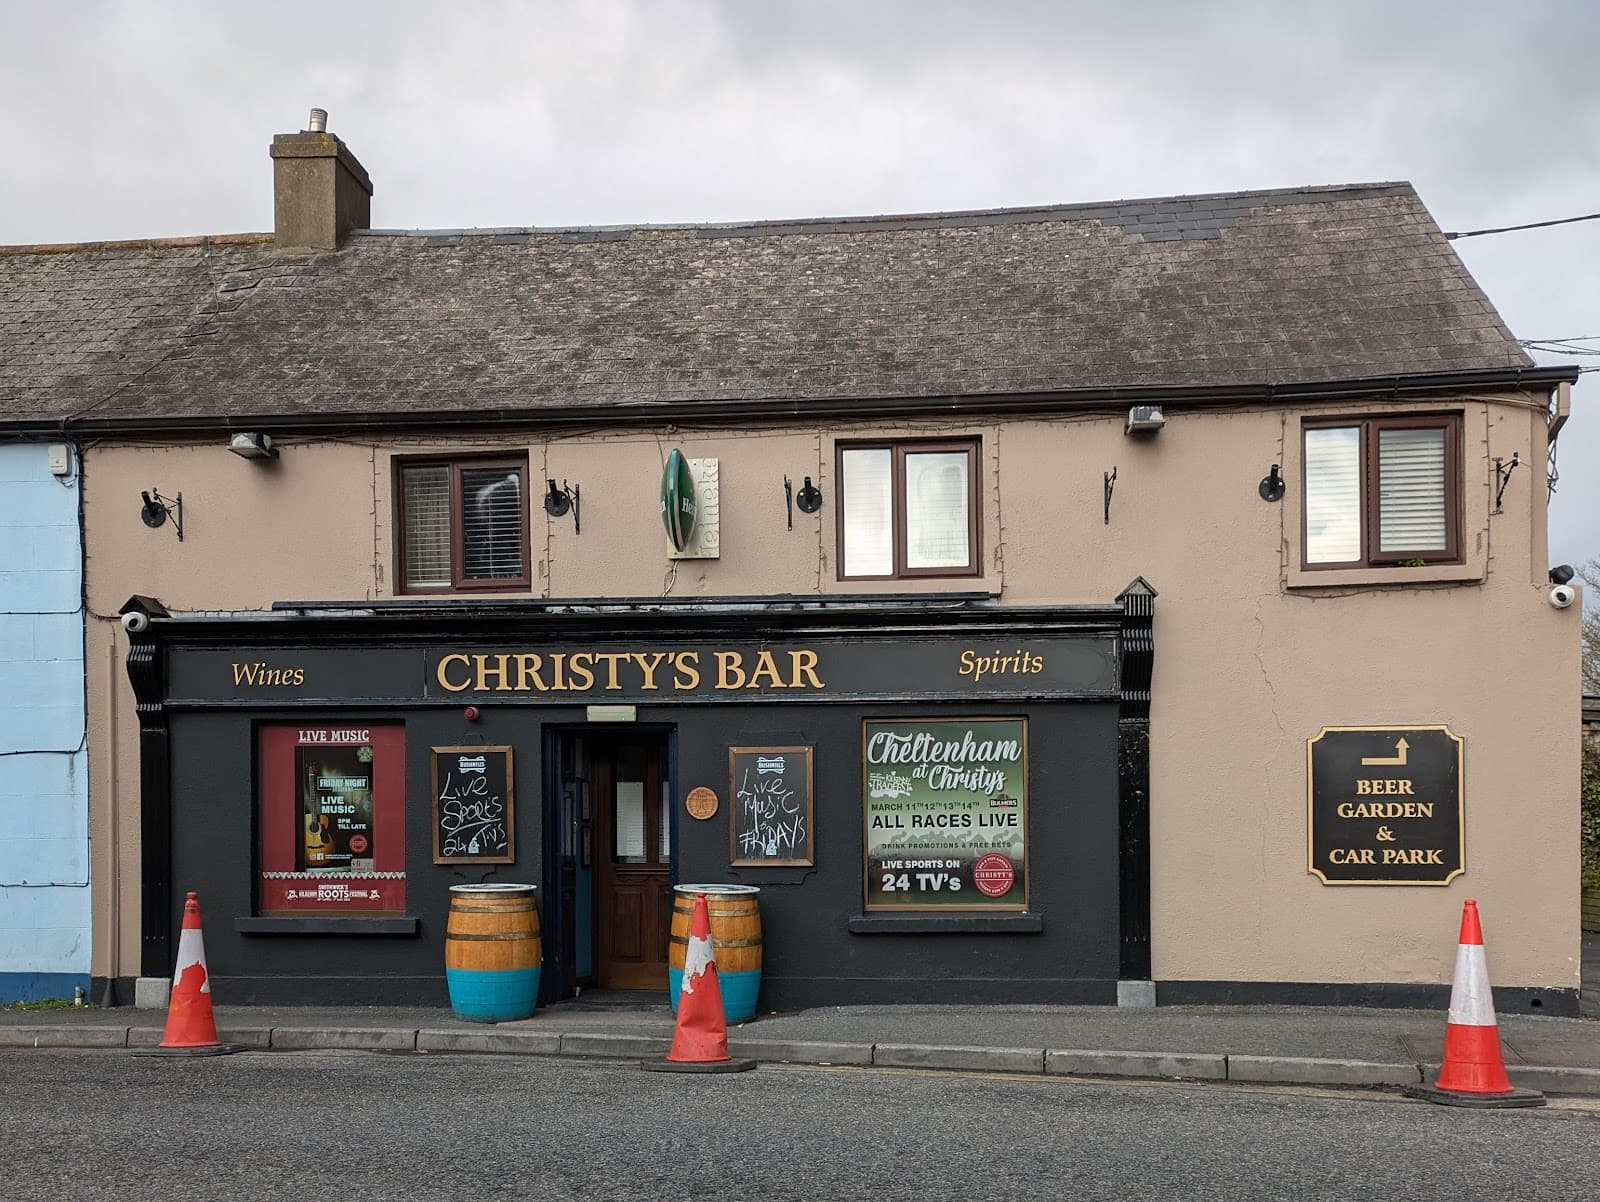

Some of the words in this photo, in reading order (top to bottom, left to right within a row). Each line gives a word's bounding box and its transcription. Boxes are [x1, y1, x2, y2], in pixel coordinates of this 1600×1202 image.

[437, 651, 700, 691] CHRISTY'S
[713, 650, 826, 689] BAR
[959, 649, 1043, 682] Spirits
[231, 662, 304, 686] Wines
[299, 730, 326, 742] LIVE
[331, 729, 370, 741] MUSIC
[868, 730, 1022, 764] Cheltenham
[440, 772, 488, 800] Live
[737, 768, 787, 798] Live
[912, 763, 929, 779] at
[928, 764, 1008, 796] Christy's
[1356, 779, 1415, 795] BEER
[321, 796, 344, 805] LIVE
[871, 803, 903, 811] MARCH
[321, 805, 355, 814] MUSIC
[1337, 803, 1434, 818] GARDEN
[872, 815, 904, 828] ALL
[912, 814, 972, 828] RACES
[979, 813, 1018, 827] LIVE
[1376, 826, 1397, 841] &
[1329, 849, 1377, 864] CAR
[1382, 849, 1444, 864] PARK
[882, 860, 903, 869] LIVE
[905, 860, 944, 869] SPORTS
[945, 860, 960, 868] ON
[882, 873, 911, 892] 24
[916, 873, 962, 892] TV's
[318, 889, 349, 898] ROOTS
